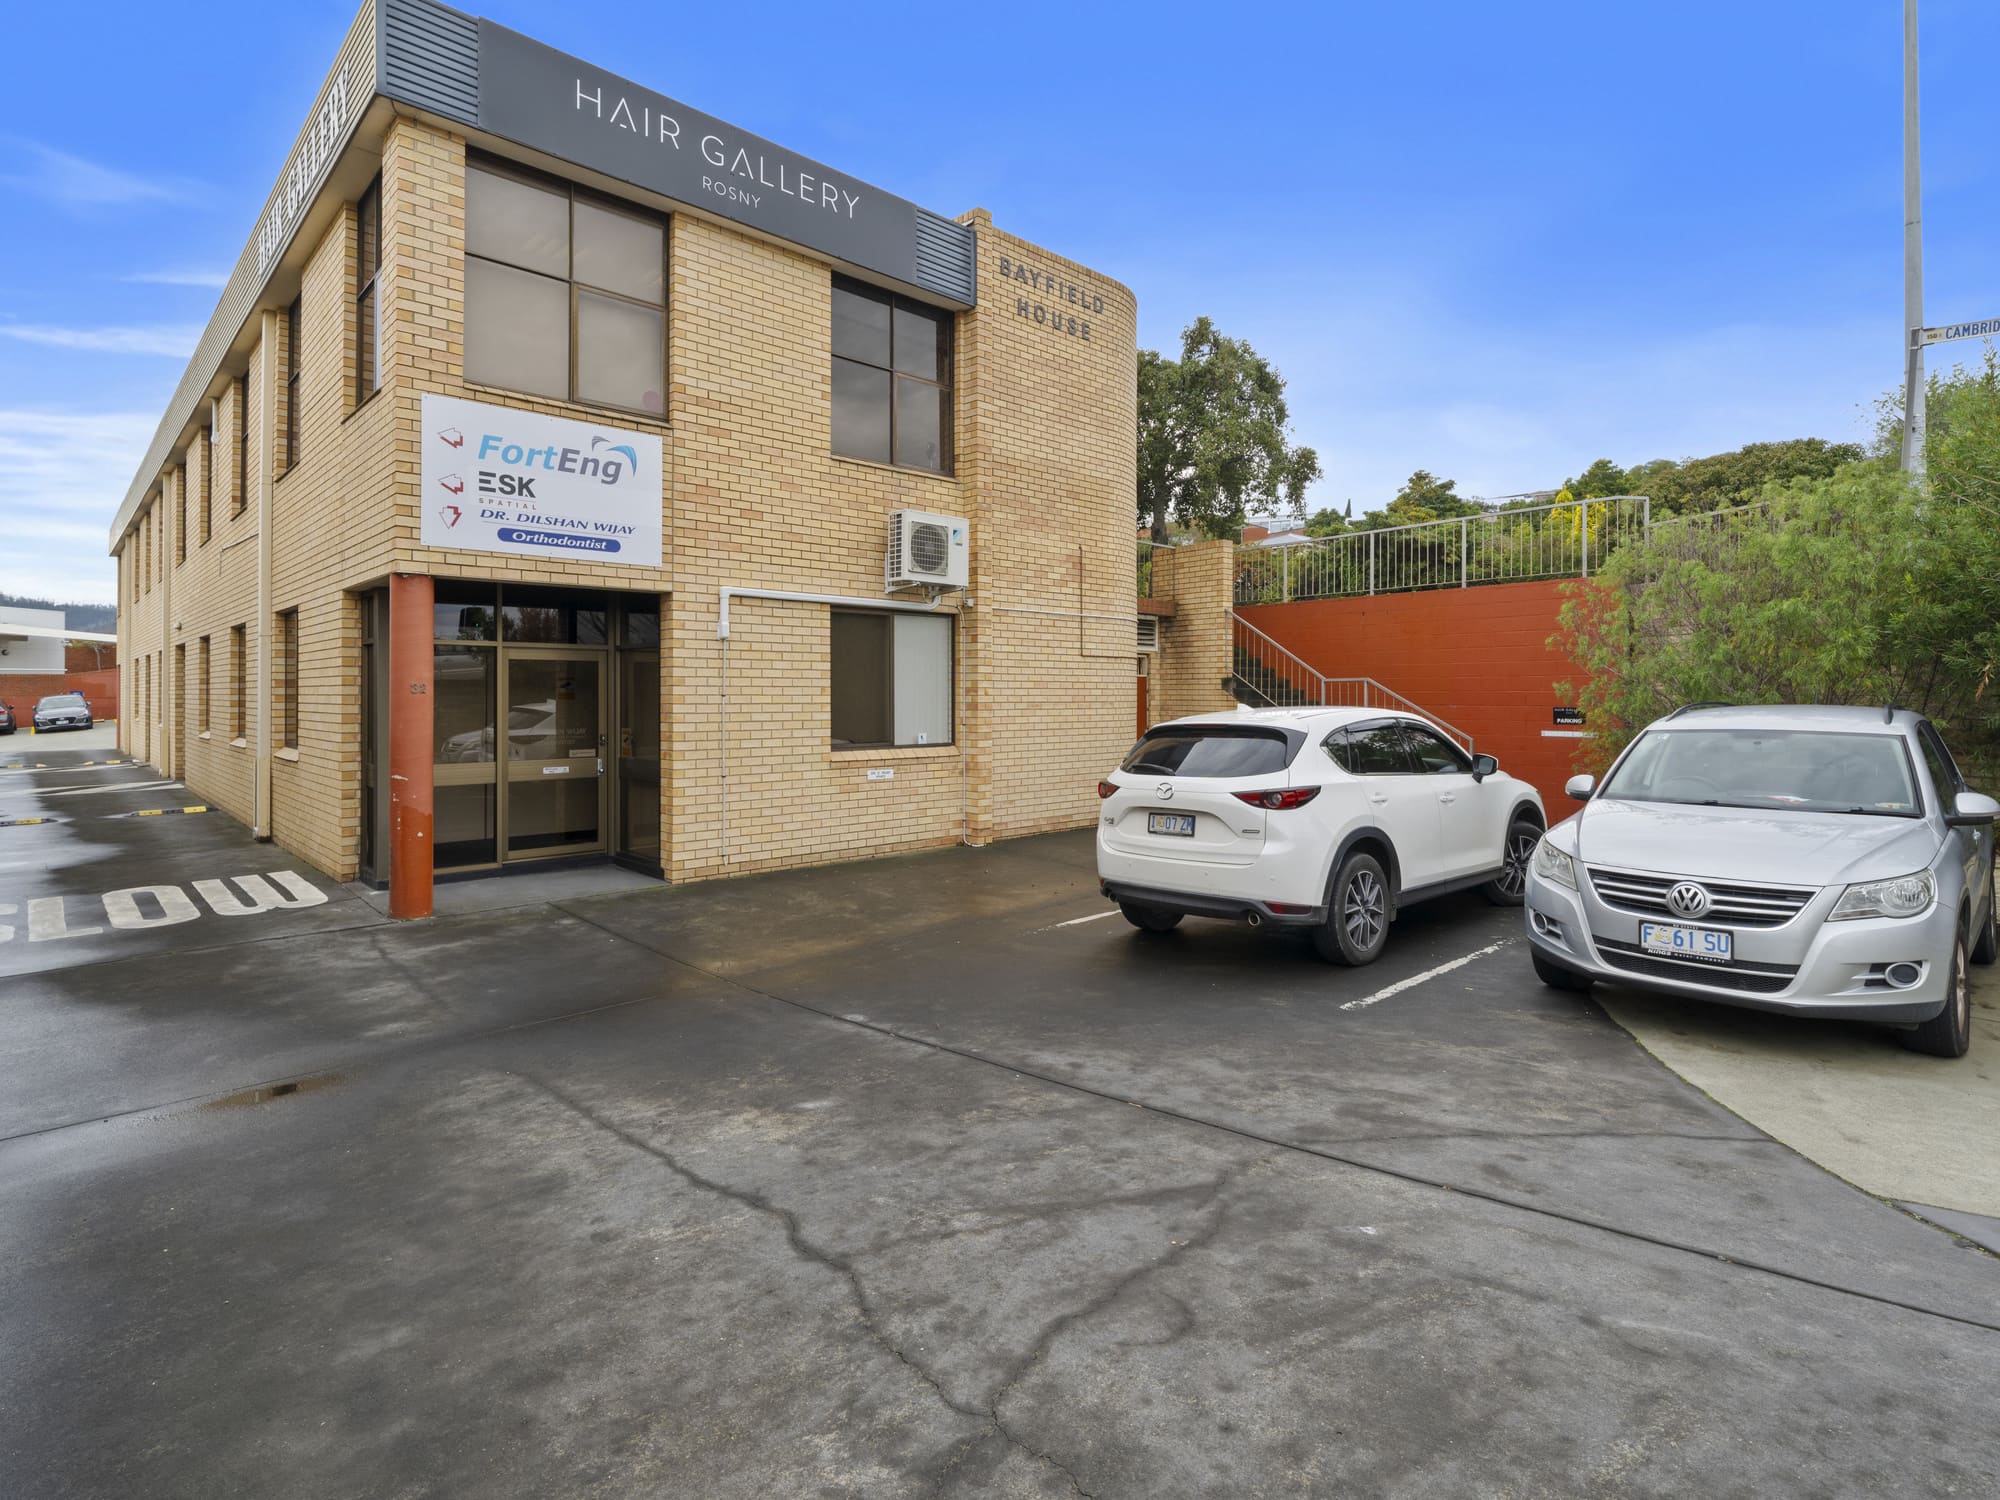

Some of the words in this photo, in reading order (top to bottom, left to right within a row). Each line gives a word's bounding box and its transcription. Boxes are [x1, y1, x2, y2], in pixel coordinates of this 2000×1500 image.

[258, 193, 285, 276] HAIR
[287, 58, 351, 220] GALLERY
[576, 78, 681, 150] HAIR
[701, 135, 860, 219] GALLERY
[702, 175, 761, 209] ROSNY
[1000, 256, 1104, 315] BAYFIELD
[1017, 297, 1090, 341] HOUSE
[477, 433, 623, 486] FortEng
[478, 470, 537, 499] ESK
[478, 497, 538, 511] SPATIAL
[480, 508, 510, 521] DR.
[516, 513, 589, 530] DILSHAN
[594, 522, 636, 535] WIJAY
[511, 531, 608, 551] Orthodontist
[0, 870, 329, 943] LOW
[1643, 925, 1655, 944] F
[1673, 930, 1694, 949] 61
[1704, 933, 1729, 954] SU
